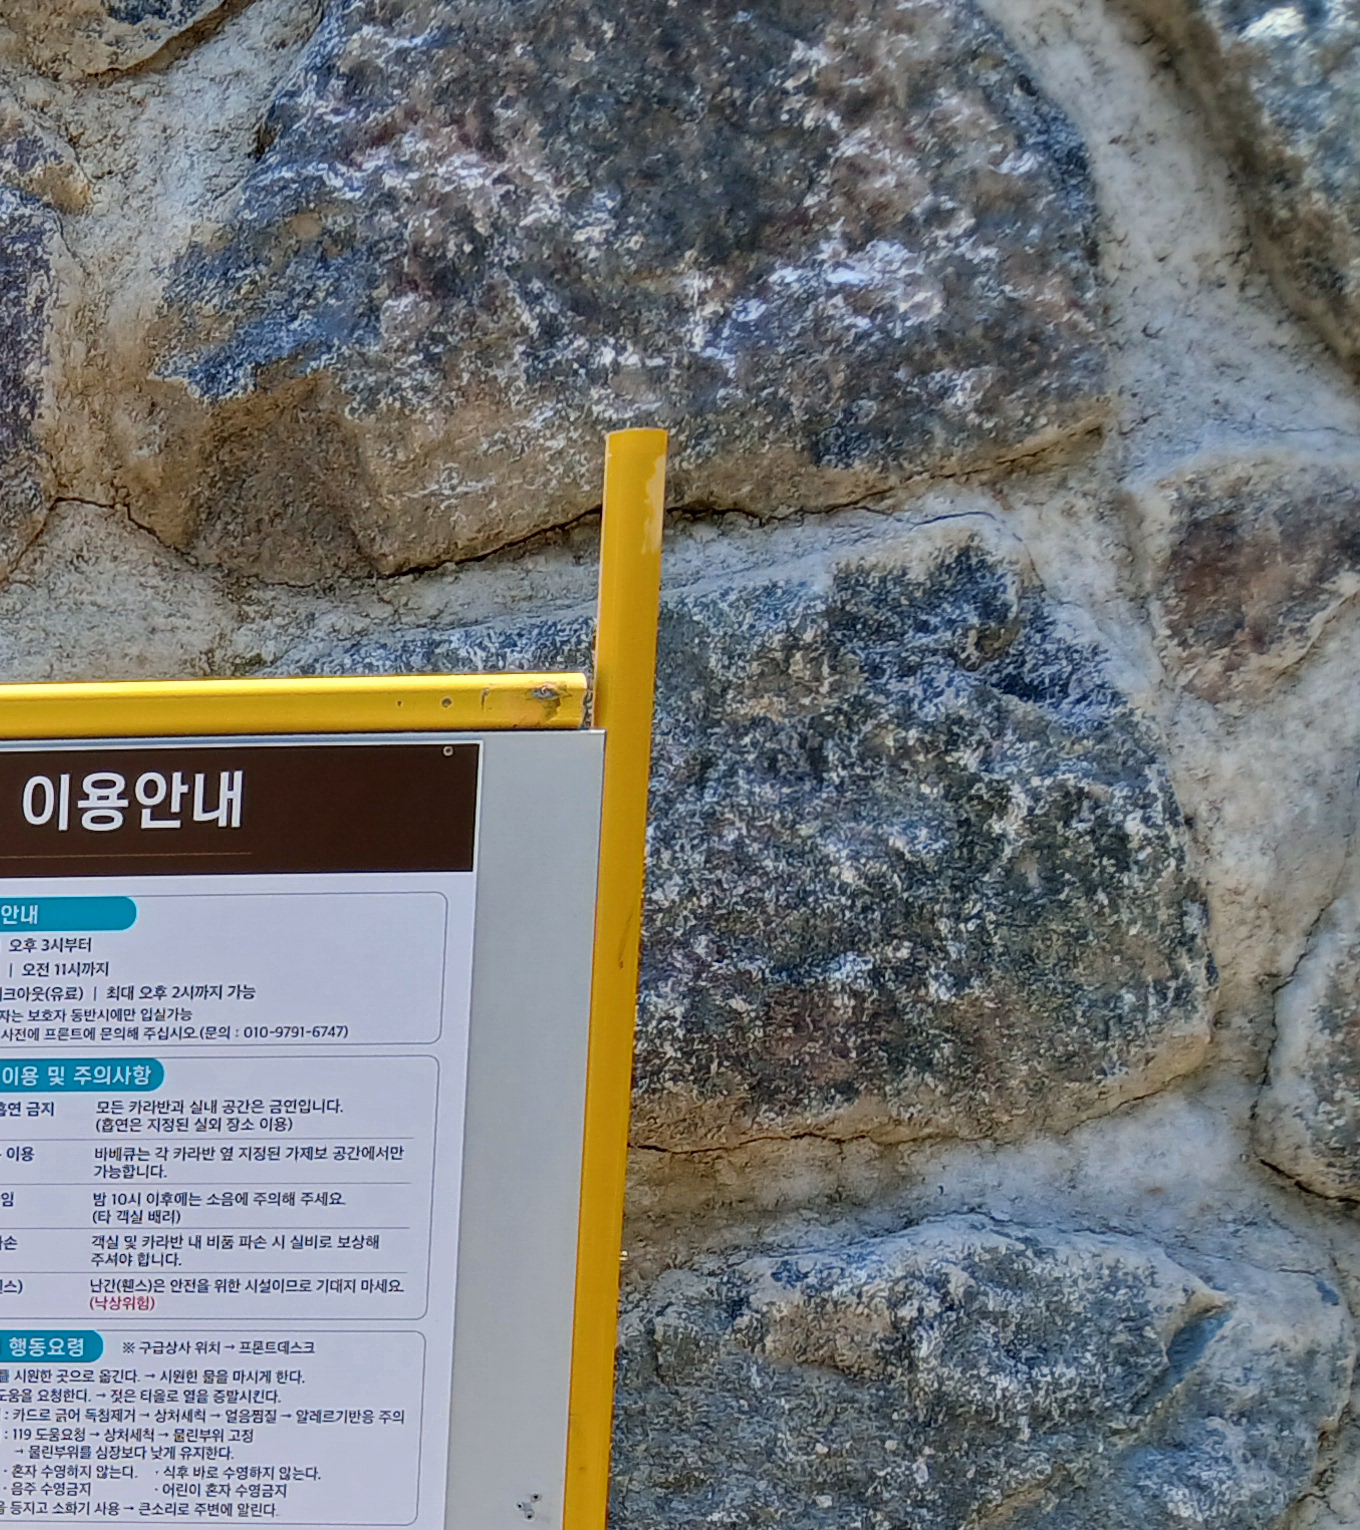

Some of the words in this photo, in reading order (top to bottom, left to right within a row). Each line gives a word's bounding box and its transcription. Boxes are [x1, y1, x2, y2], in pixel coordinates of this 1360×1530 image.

[23, 772, 243, 831] 이용안내
[9, 938, 37, 953] 오후
[41, 937, 92, 953] 3시부터
[22, 962, 49, 978] 오전
[54, 962, 109, 977] 11시까지
[106, 985, 135, 1001] 최대
[138, 985, 167, 1001] 오후
[172, 985, 223, 1000] 2시까지
[227, 984, 256, 1000] 가능
[28, 1009, 66, 1023] 보호자
[70, 1008, 136, 1023] 동반시에만
[140, 1008, 193, 1022] 입실가능
[1, 1028, 40, 1042] 사전에
[44, 1027, 96, 1041] 프론트에
[100, 1027, 139, 1041] 문의해
[244, 1026, 349, 1039] 010-9791-6747)
[2, 1066, 39, 1086] 이용
[48, 1066, 65, 1086] 및
[74, 1066, 151, 1085] 주의사항
[26, 1101, 55, 1117] 금지
[96, 1100, 124, 1115] 모든
[190, 1100, 218, 1115] 실내
[222, 1099, 265, 1115] 공간은
[147, 1118, 189, 1133] 지정된
[194, 1117, 222, 1133] 실외
[260, 1117, 293, 1132] 이용)
[6, 1146, 35, 1162] 이용
[94, 1147, 151, 1162] 바베큐는
[155, 1147, 169, 1162] 각
[173, 1147, 216, 1162] 카라반
[220, 1146, 234, 1162] 옆
[238, 1146, 281, 1162] 지정된
[333, 1146, 405, 1161] 공간에서만
[94, 1164, 167, 1180] 가능합니다.
[93, 1192, 107, 1207] 밤
[112, 1192, 141, 1207] 10시
[146, 1192, 203, 1207] 이후에는
[206, 1192, 249, 1207] 소음에
[253, 1192, 295, 1207] 주의해
[92, 1210, 111, 1225] (타
[117, 1210, 143, 1225] 객실
[92, 1235, 119, 1250] 객실
[124, 1235, 137, 1250] 및
[142, 1235, 184, 1250] 카라반
[188, 1235, 202, 1250] 내
[239, 1235, 267, 1250] 파손
[272, 1235, 285, 1250] 시
[290, 1235, 332, 1250] 실비로
[337, 1235, 379, 1250] 보상해
[138, 1252, 182, 1268] 합니다.
[170, 1278, 211, 1294] 안전을
[214, 1279, 241, 1294] 위한
[245, 1279, 312, 1294] 시설이므로
[316, 1279, 356, 1294] 기대지
[90, 1296, 155, 1311] (낙상위험)
